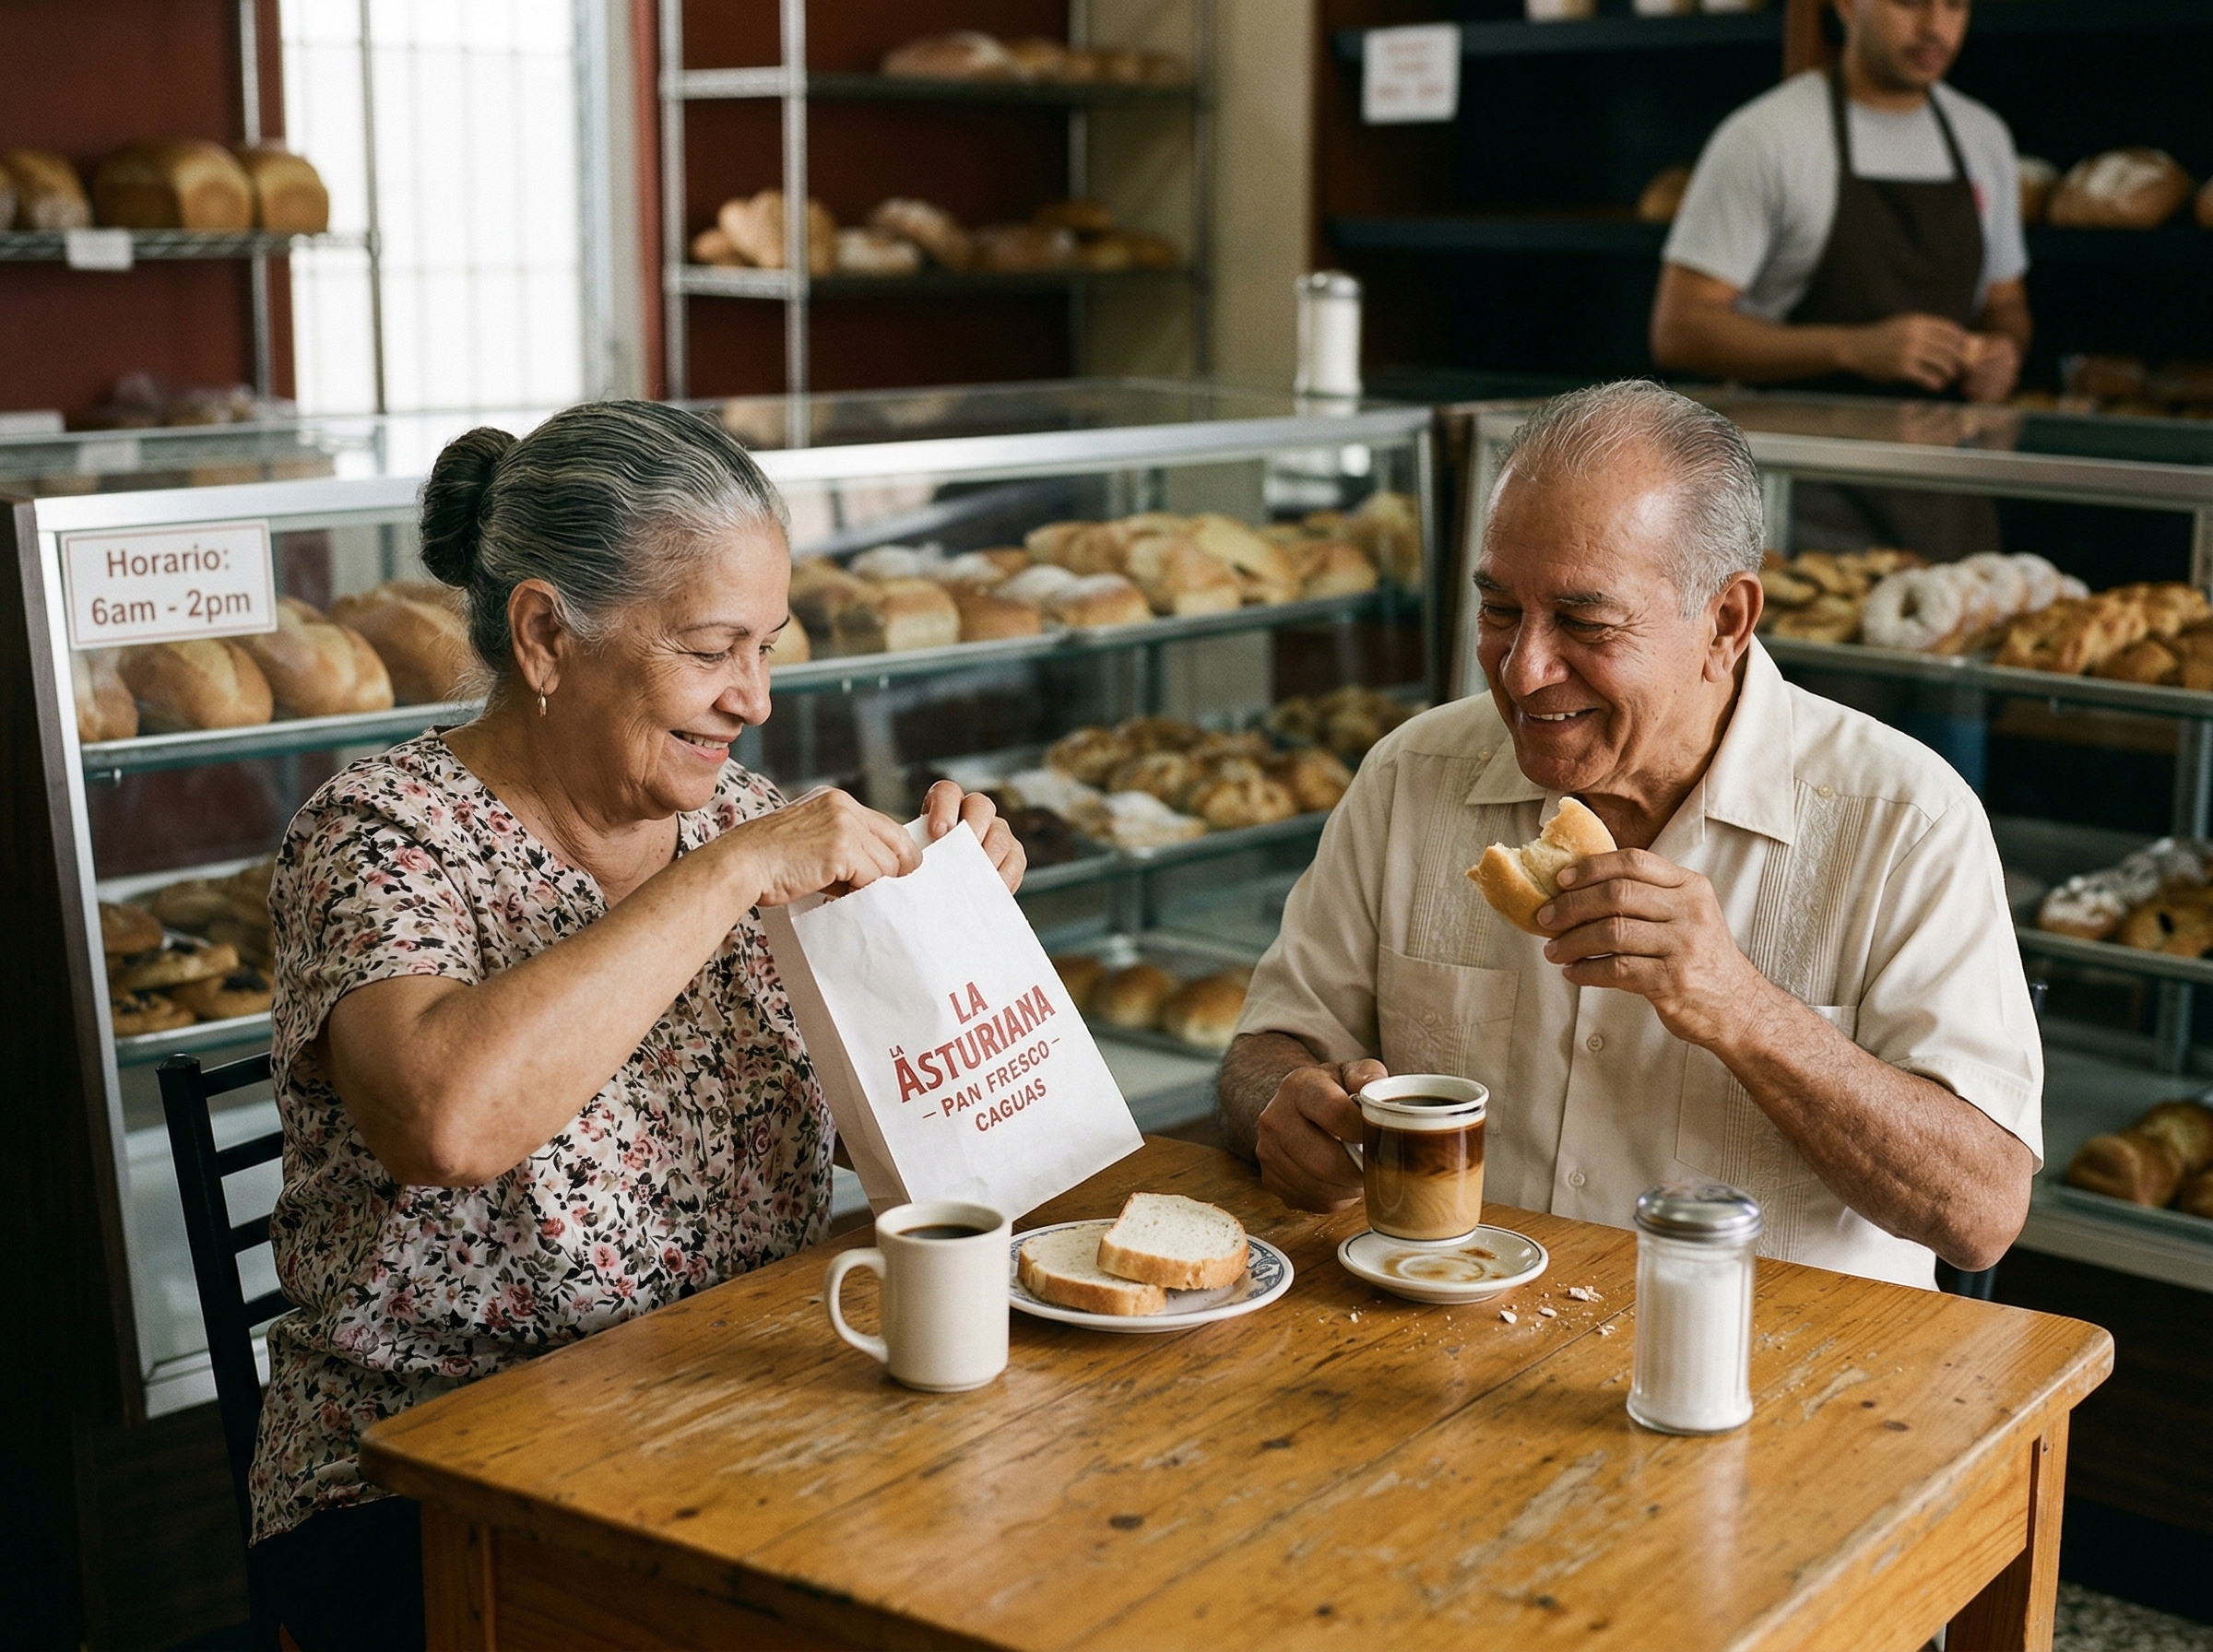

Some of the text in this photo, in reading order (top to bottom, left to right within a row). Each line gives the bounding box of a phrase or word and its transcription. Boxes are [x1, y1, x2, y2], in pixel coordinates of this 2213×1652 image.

[106, 543, 230, 578] Horario:
[91, 597, 156, 626] 6am
[186, 589, 251, 623] 2pm
[948, 981, 988, 1025] LA
[888, 1044, 905, 1059] LA
[893, 985, 1057, 1103] ASTURIANA
[941, 1040, 1050, 1117] PAN FRESCO
[975, 1078, 1047, 1132] CAGUAS
